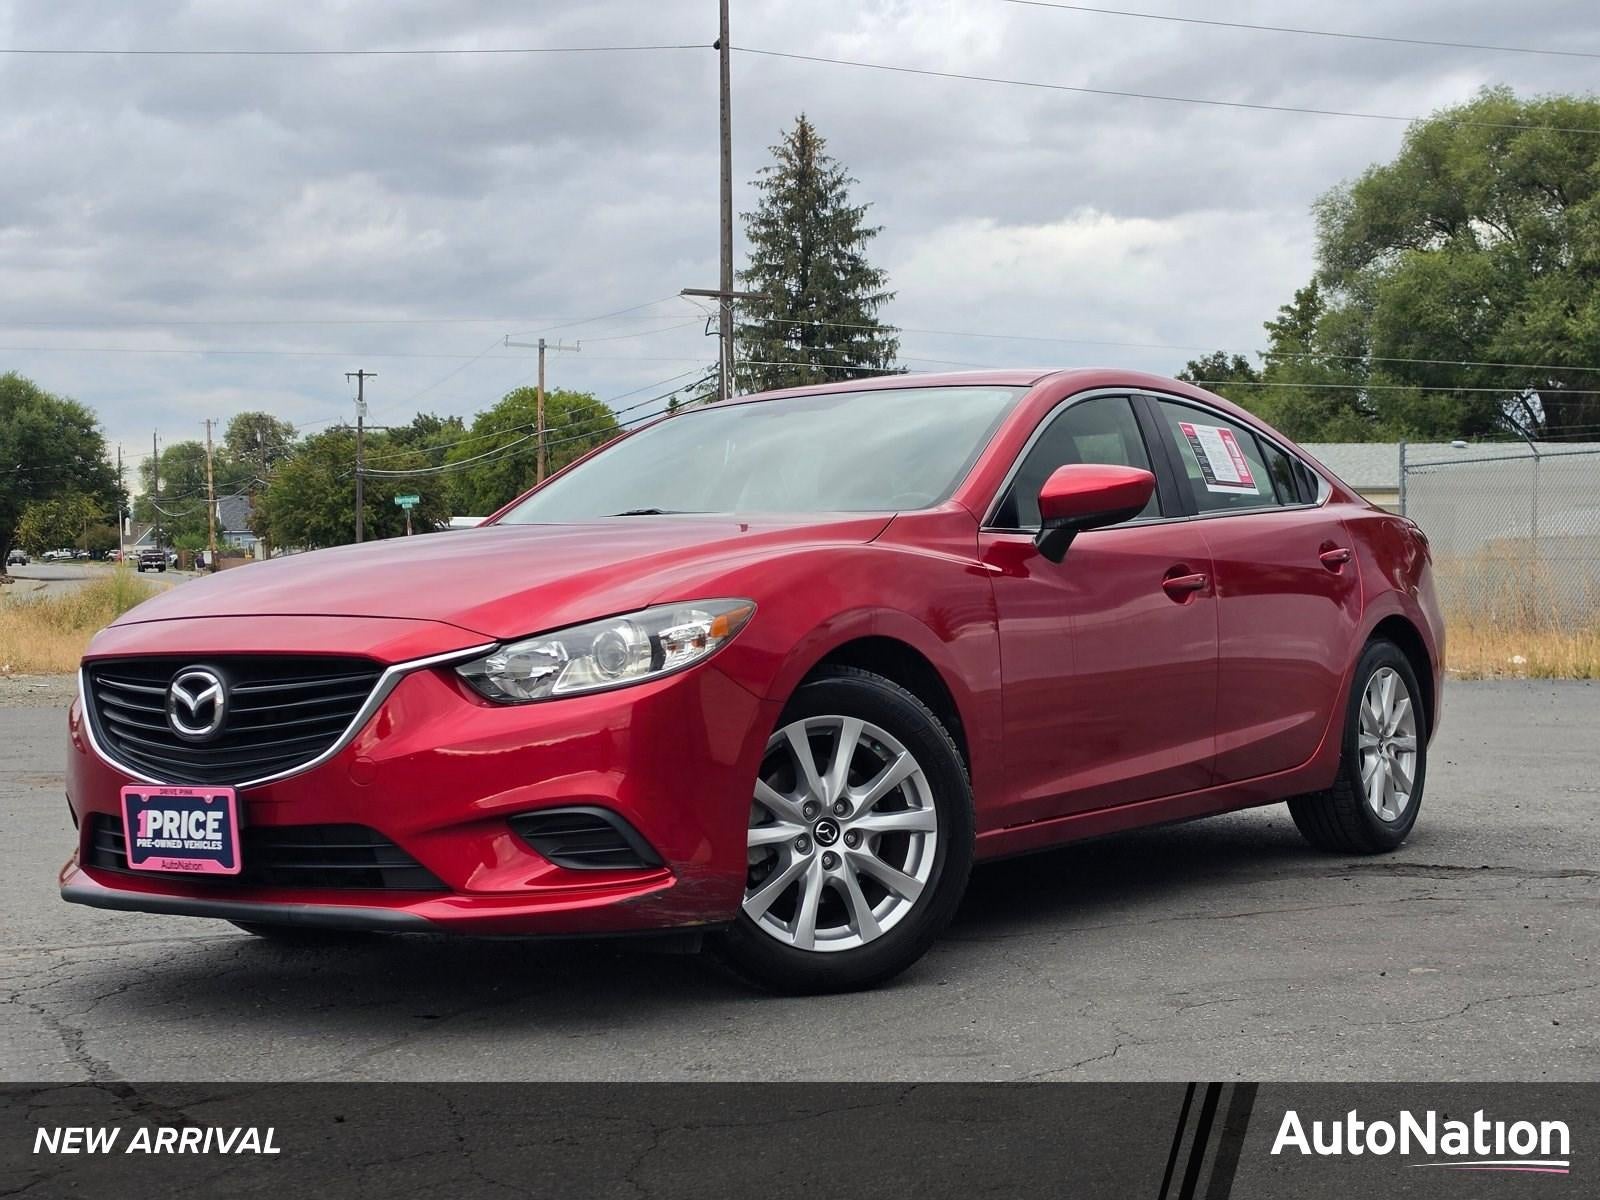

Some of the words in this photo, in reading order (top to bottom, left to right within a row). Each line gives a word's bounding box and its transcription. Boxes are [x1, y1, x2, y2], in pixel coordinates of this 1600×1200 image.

[136, 838, 182, 848] PRE-OWNED
[183, 840, 223, 850] VEHICLES
[161, 860, 203, 871] AutoNation
